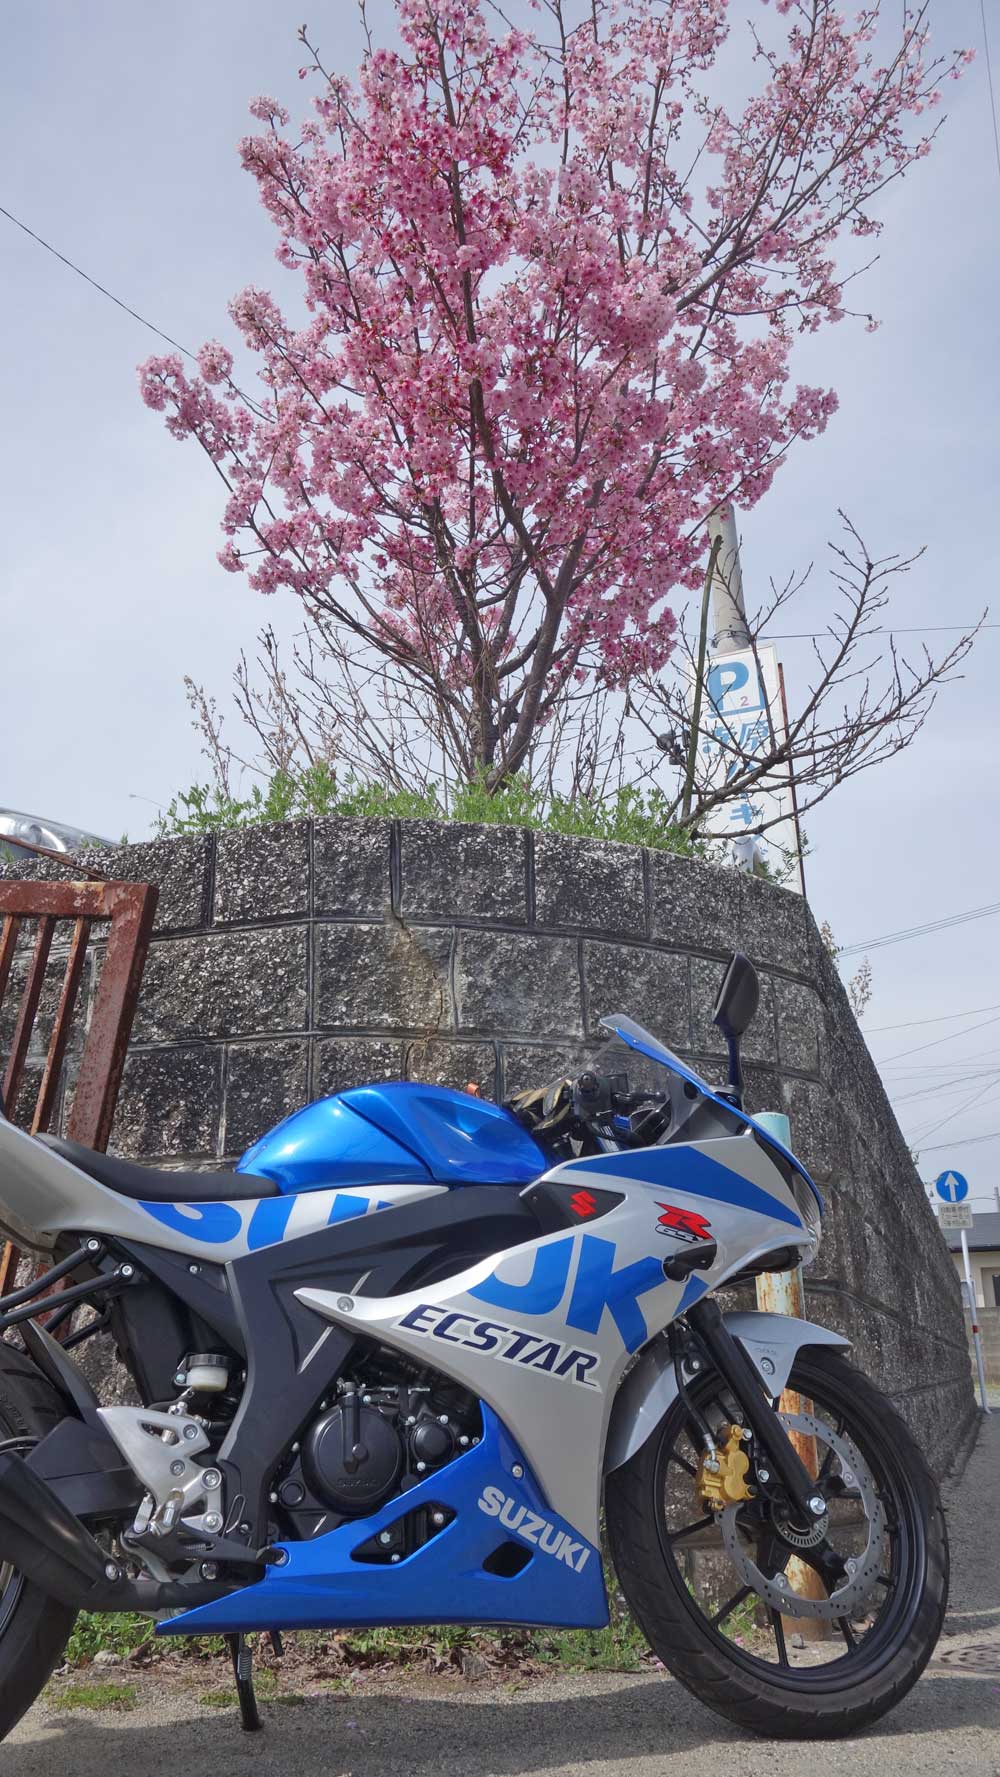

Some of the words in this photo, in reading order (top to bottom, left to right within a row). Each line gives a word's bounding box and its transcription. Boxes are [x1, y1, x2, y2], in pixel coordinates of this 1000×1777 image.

[708, 661, 750, 712] P
[740, 695, 750, 707] 2
[397, 1303, 601, 1387] ECSTAR
[477, 1486, 591, 1574] SUZUKI
